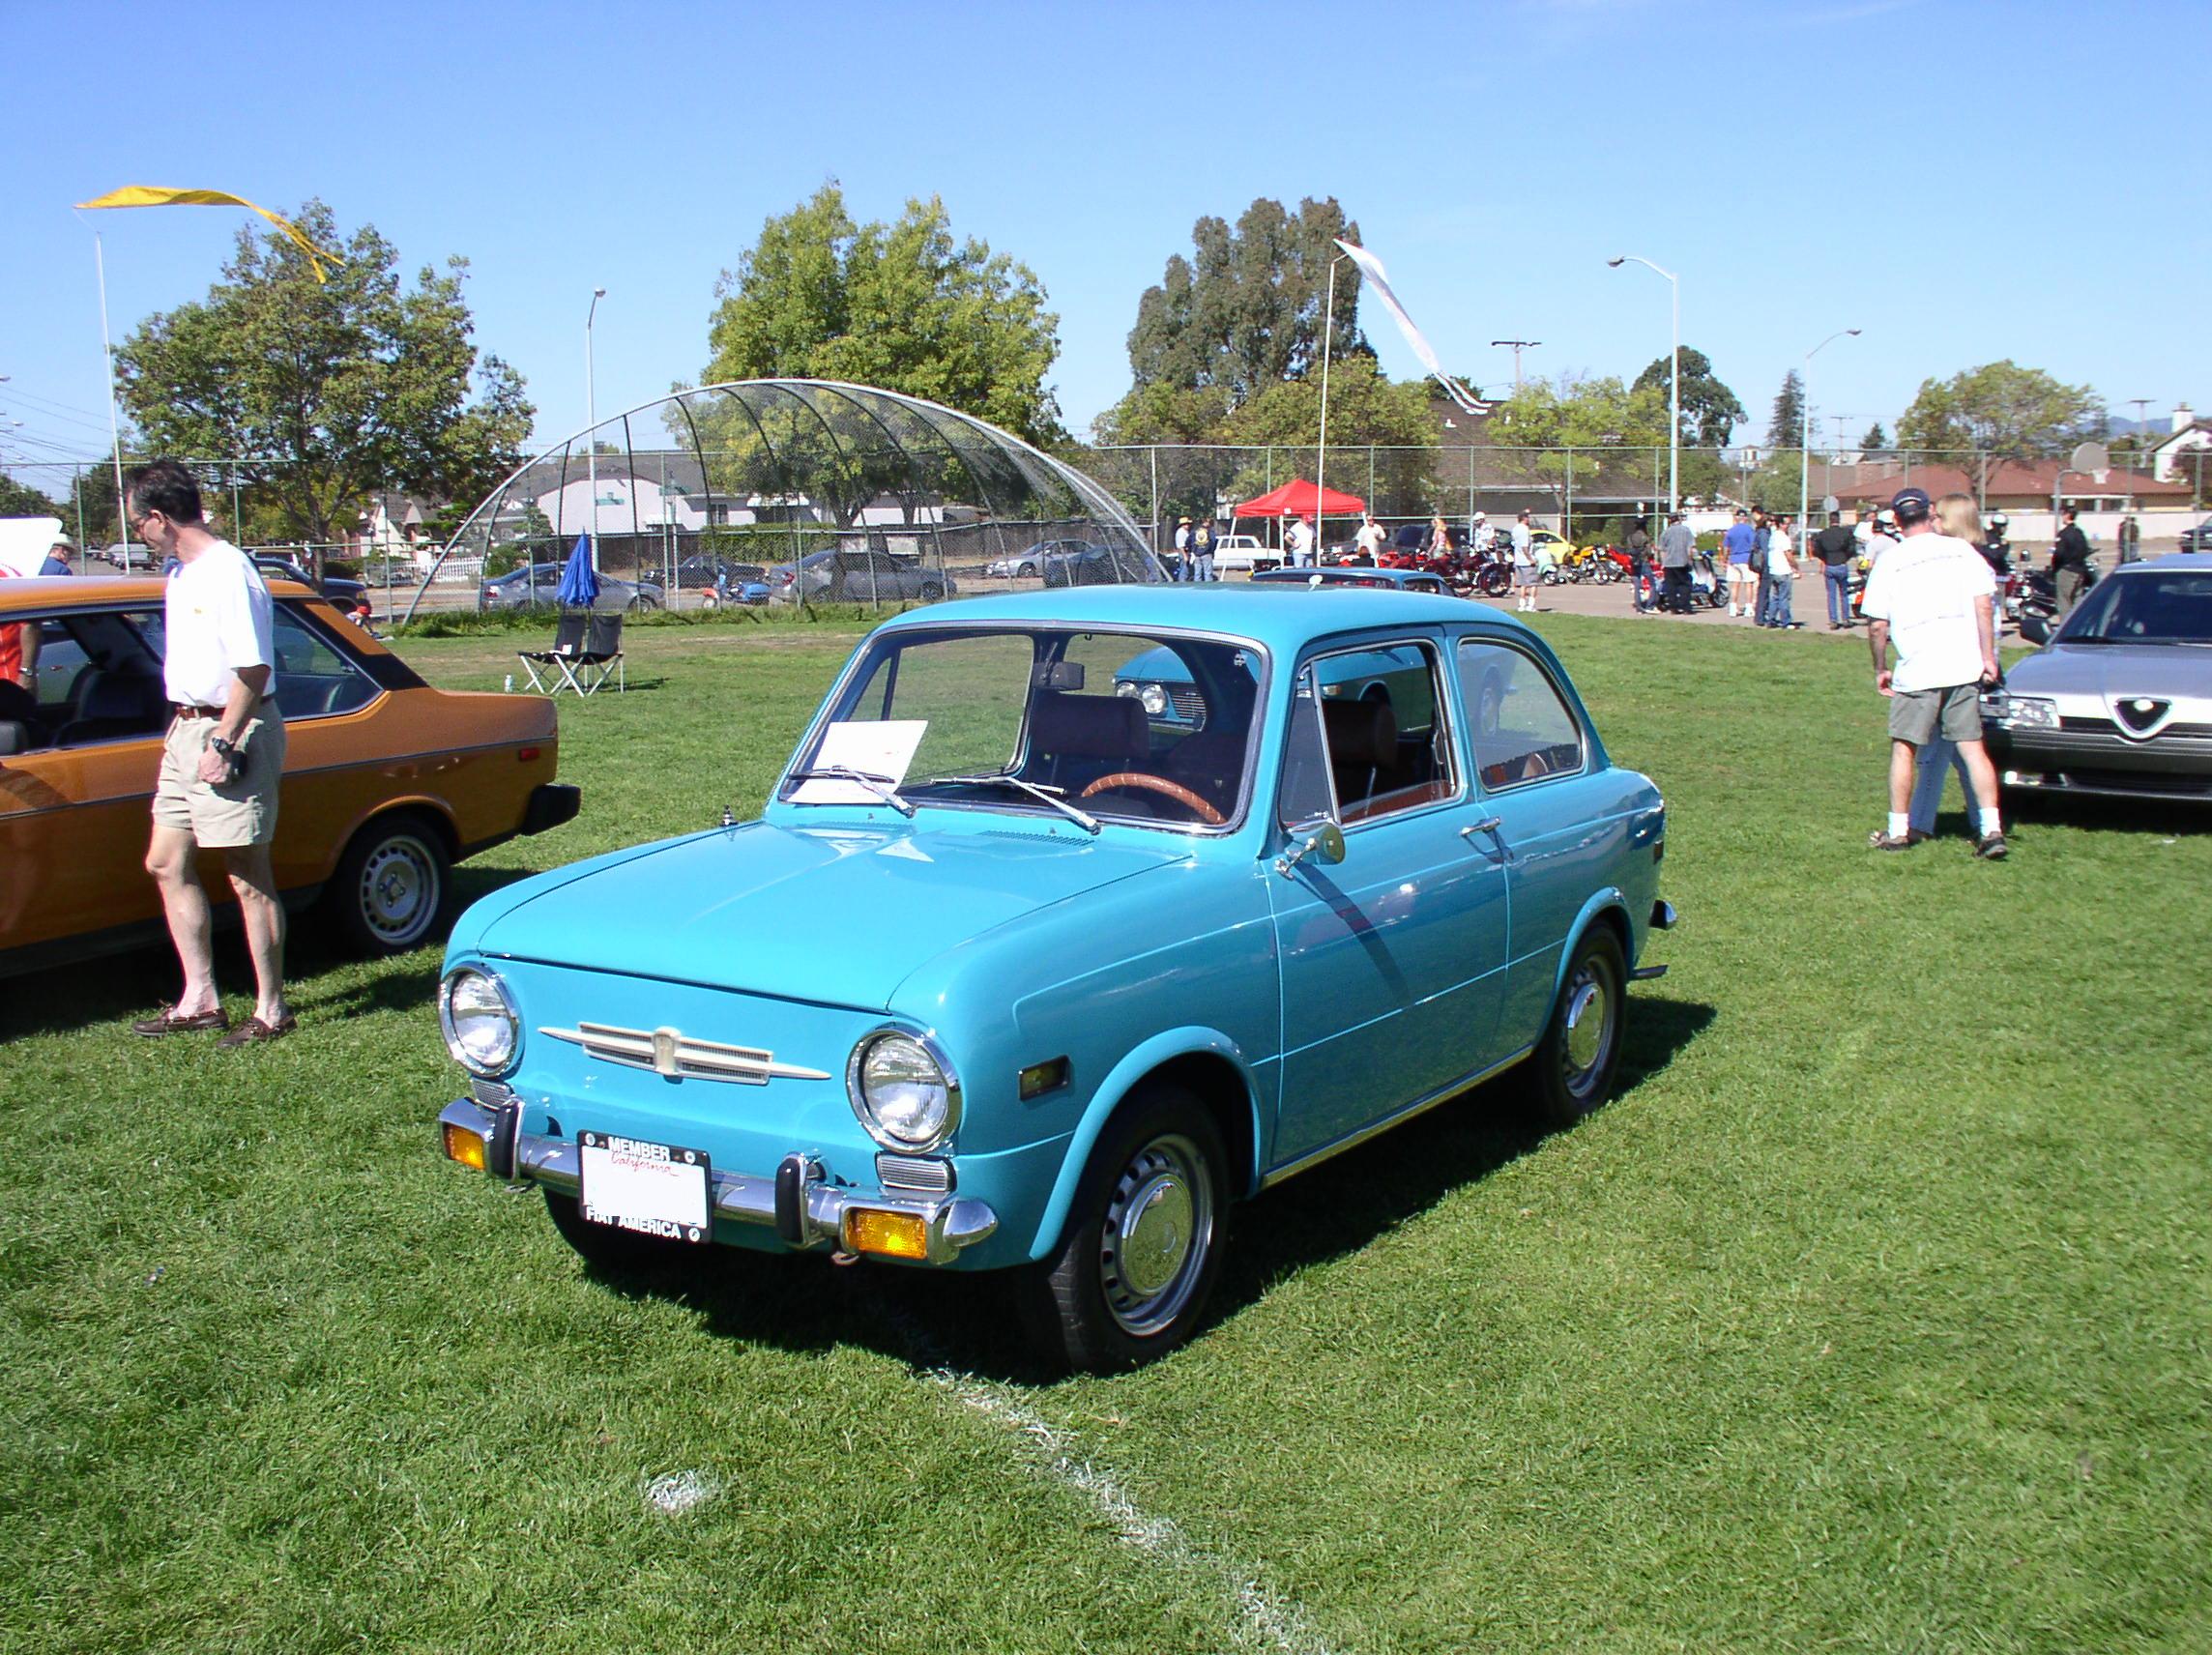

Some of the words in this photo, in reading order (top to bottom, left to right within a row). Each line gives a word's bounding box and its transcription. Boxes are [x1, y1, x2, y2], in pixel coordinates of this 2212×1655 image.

[608, 1136, 671, 1162] MEMBER
[586, 1205, 617, 1225] FIAT
[618, 1215, 682, 1238] AMERICA
